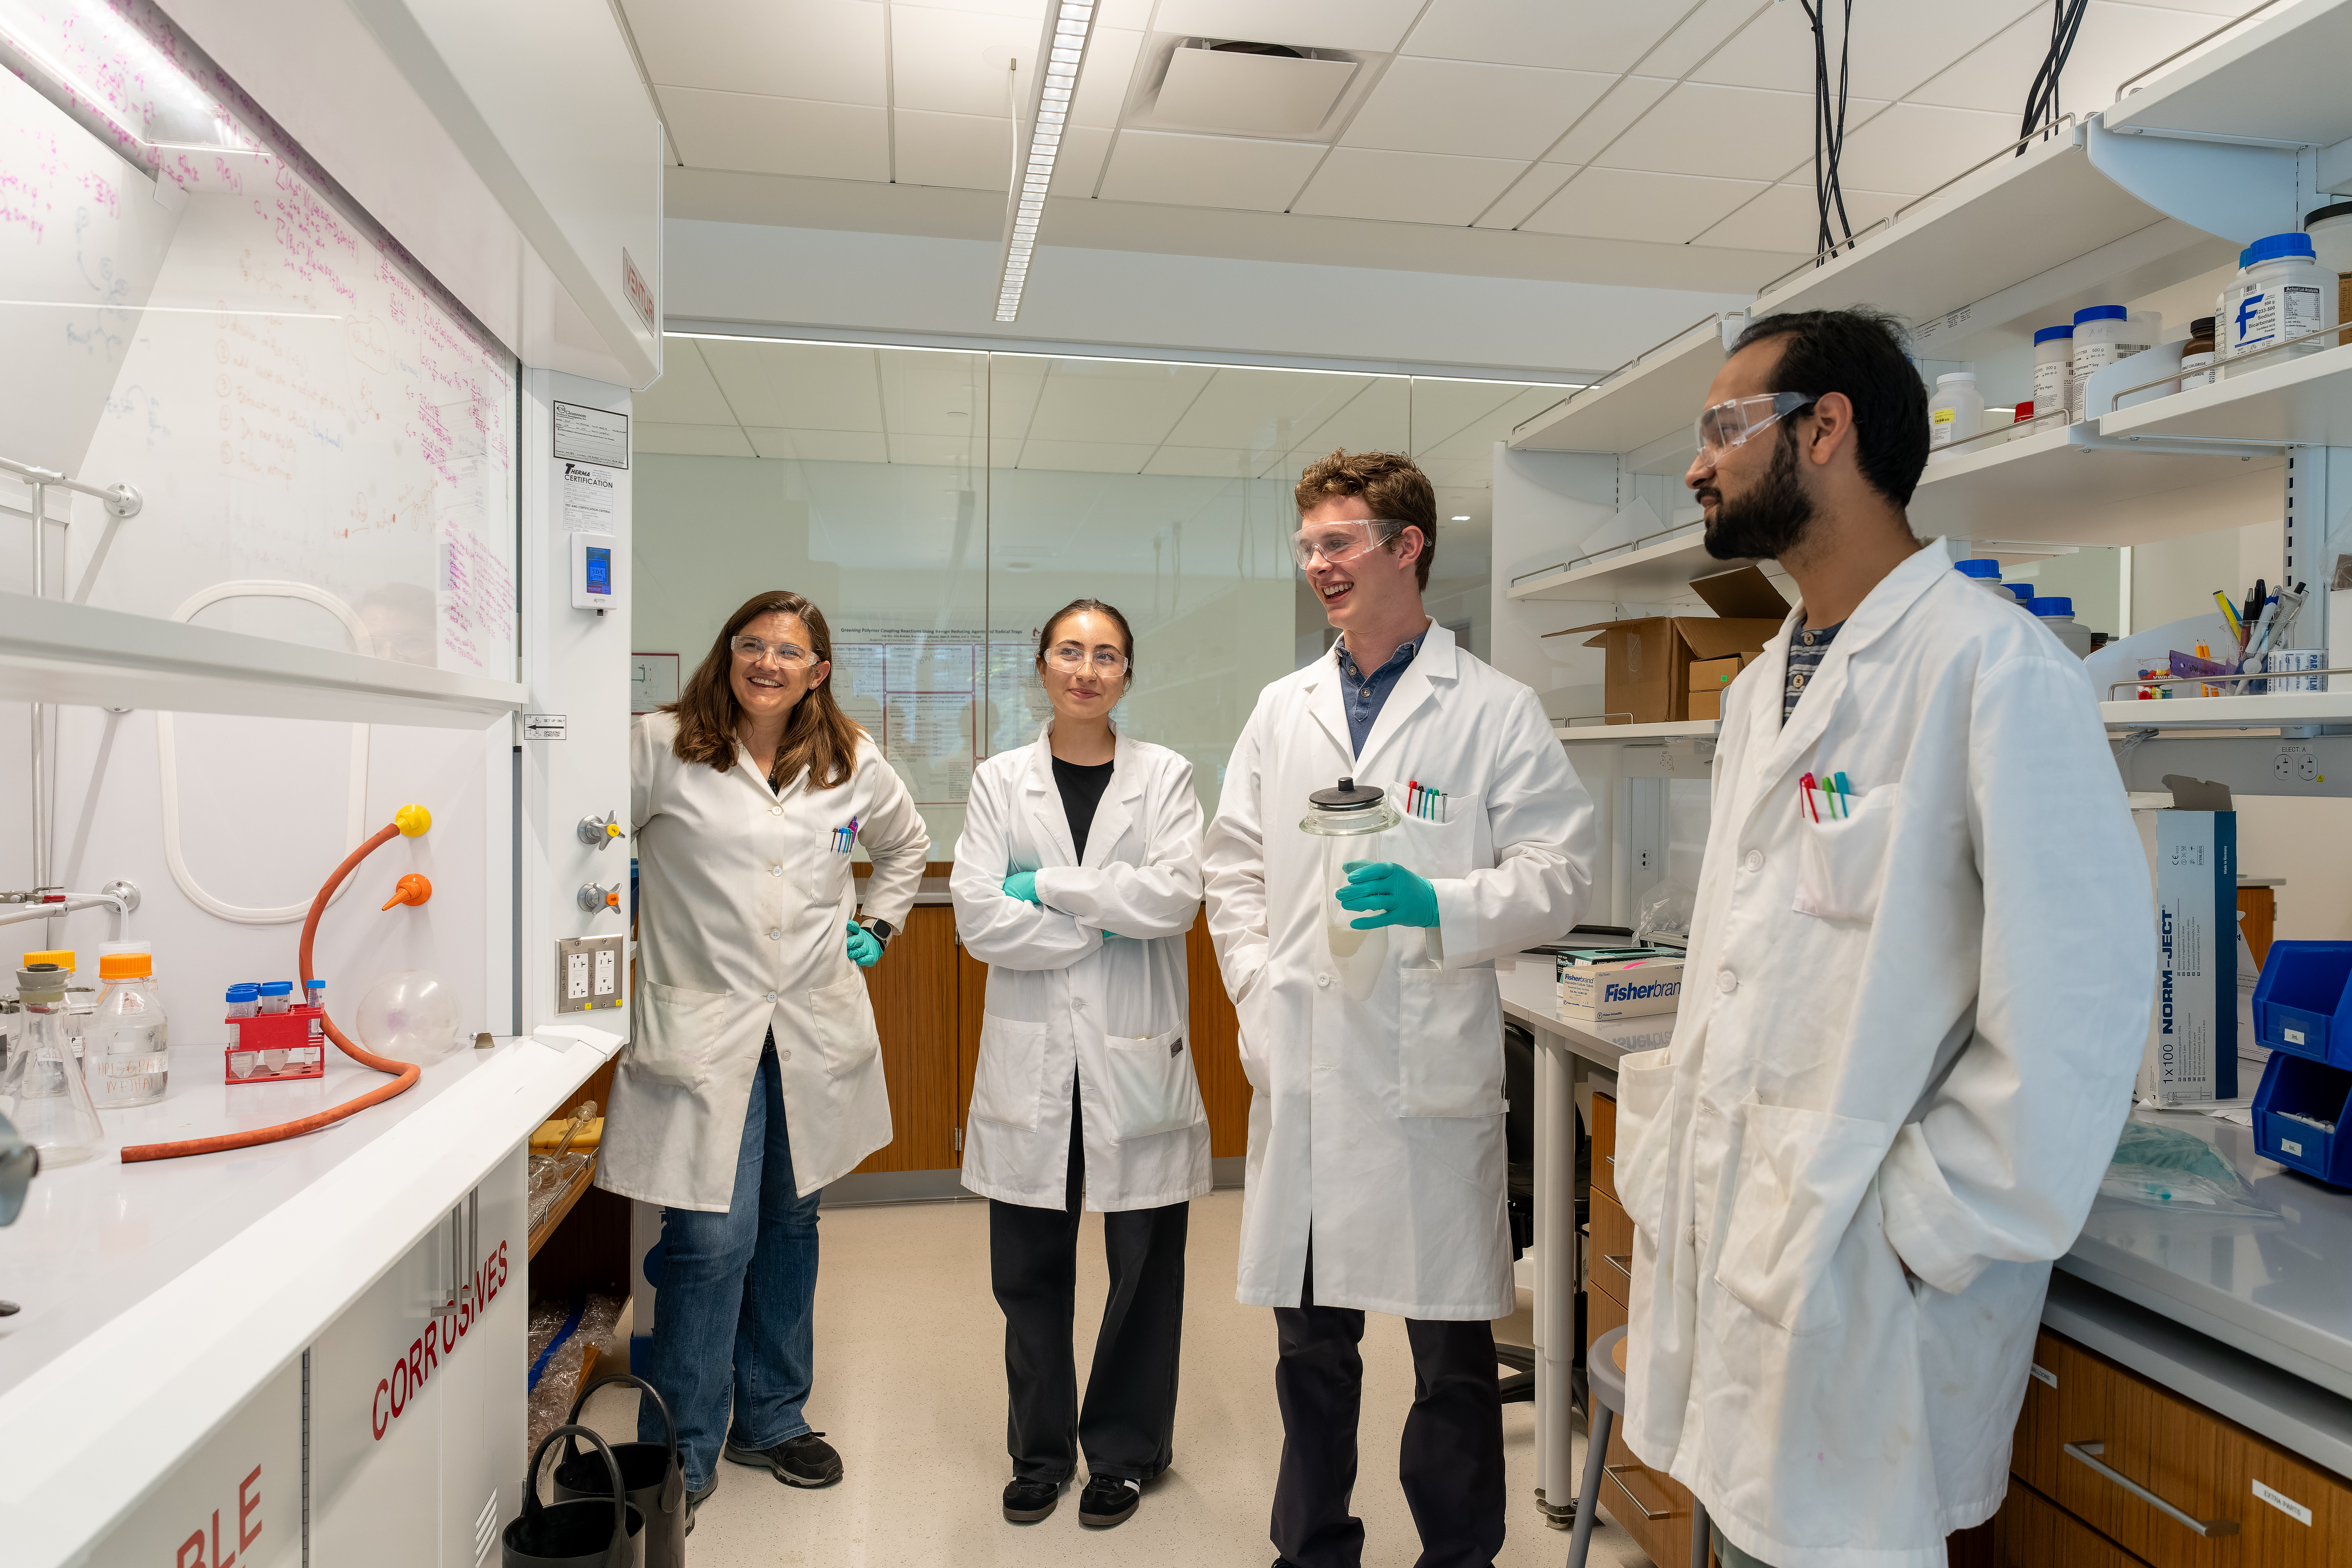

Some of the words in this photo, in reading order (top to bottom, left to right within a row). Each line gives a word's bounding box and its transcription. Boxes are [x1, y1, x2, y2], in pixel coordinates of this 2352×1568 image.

[626, 258, 654, 325] VENTURI
[2249, 318, 2276, 328] Bicarbonate
[564, 474, 613, 488] CERTIFICATION
[565, 463, 590, 477] THERMA
[2309, 654, 2318, 690] PARILM
[1604, 980, 1681, 1003] Fisherbran
[2162, 1044, 2173, 1067] 100
[372, 1240, 508, 1441] CORROSIVES
[2264, 1490, 2282, 1505] EXTRA
[2283, 1500, 2301, 1517] PARTS
